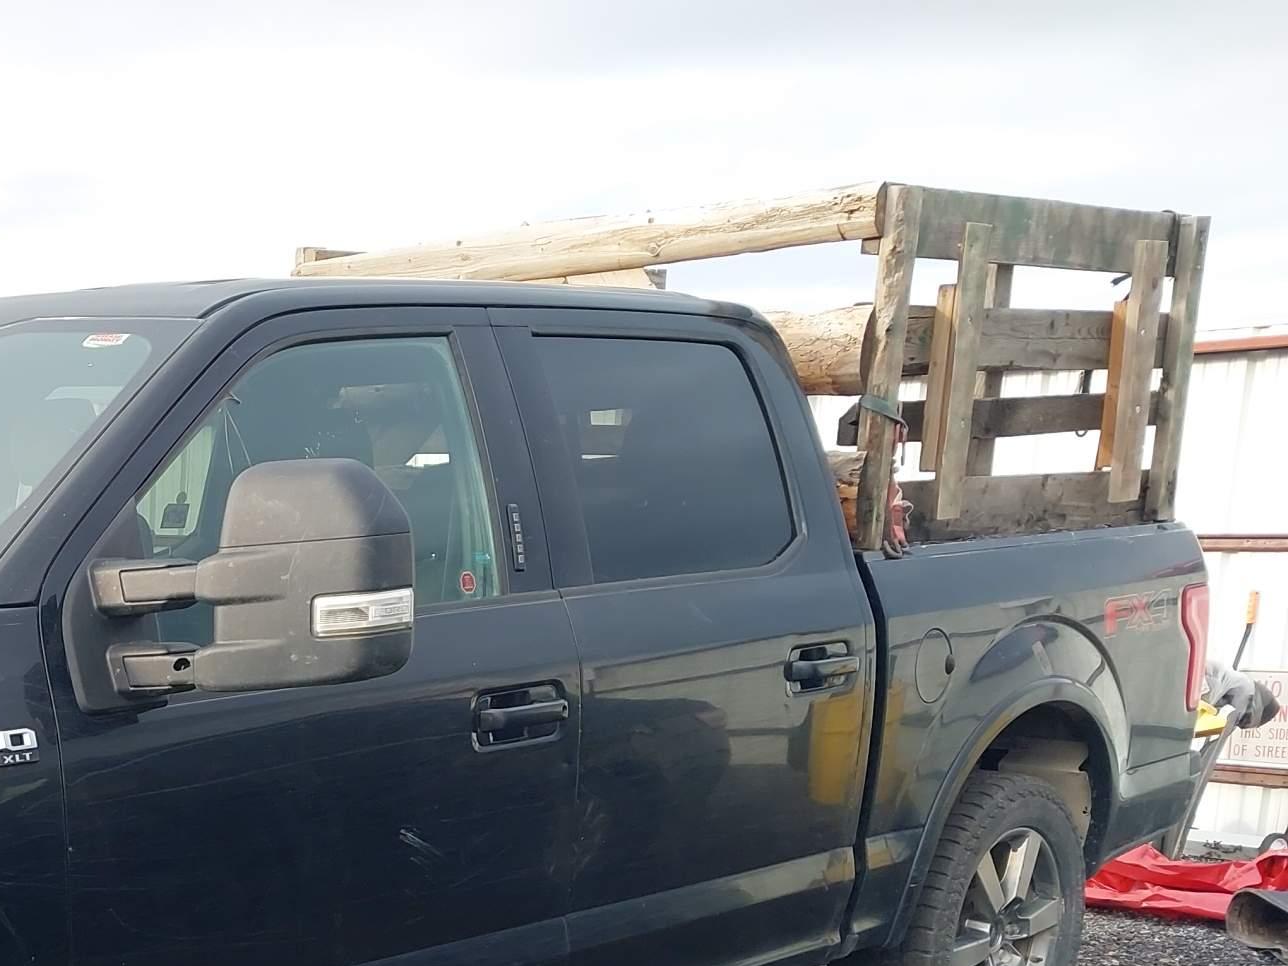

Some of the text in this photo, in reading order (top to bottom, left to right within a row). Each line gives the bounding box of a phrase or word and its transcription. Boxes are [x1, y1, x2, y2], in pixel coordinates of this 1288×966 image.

[1104, 588, 1172, 639] FX4
[1233, 744, 1247, 756] OF
[2, 752, 32, 765] XLT
